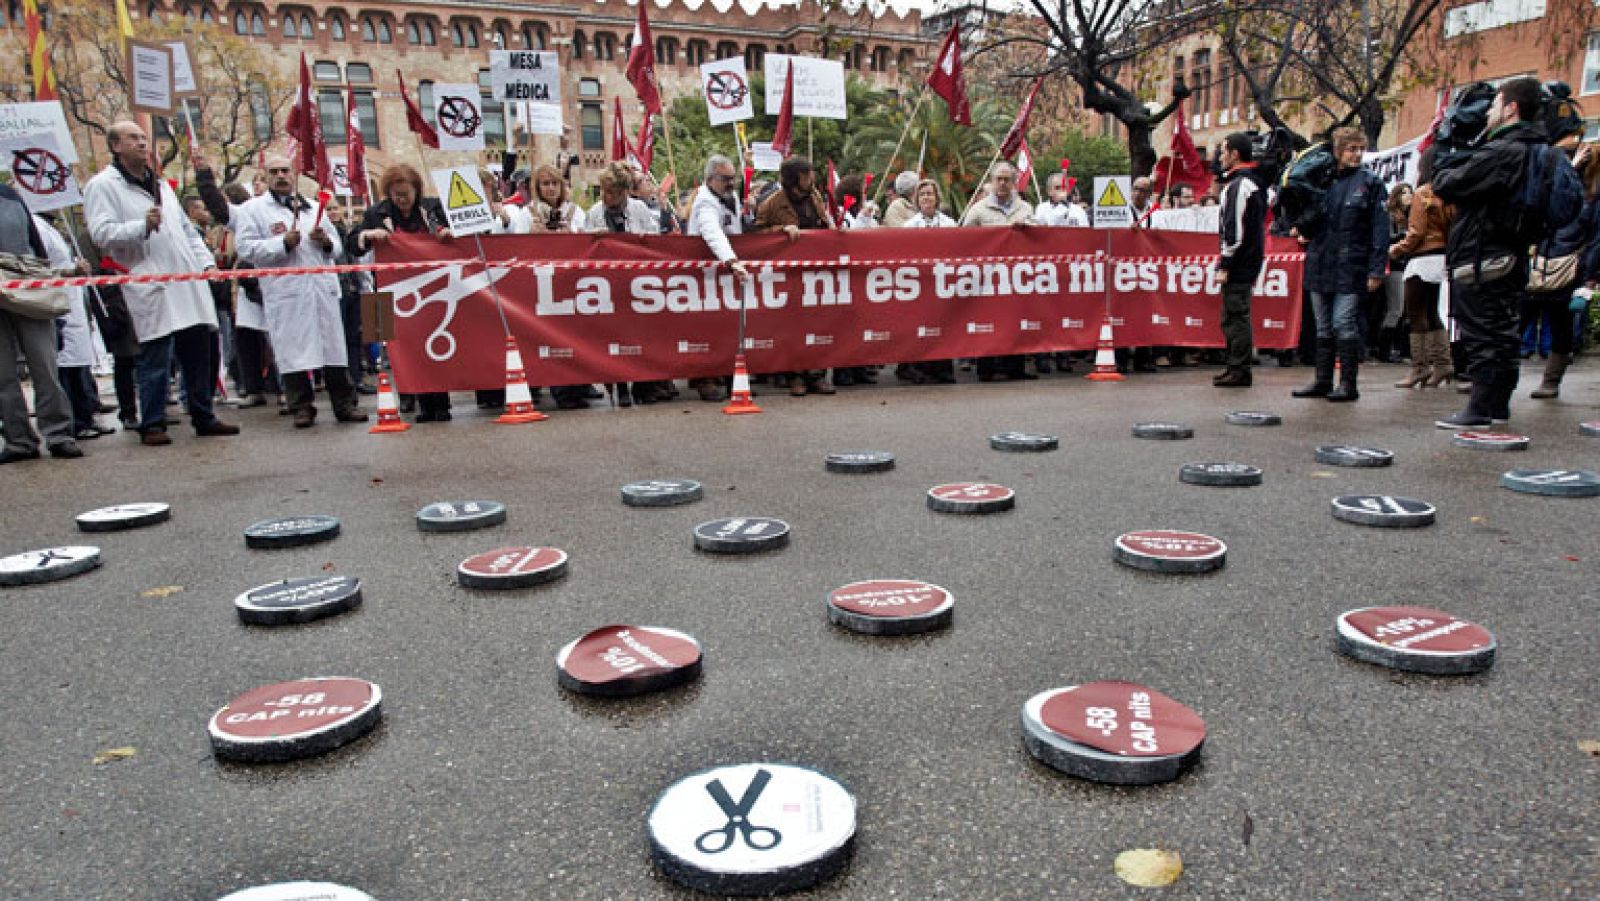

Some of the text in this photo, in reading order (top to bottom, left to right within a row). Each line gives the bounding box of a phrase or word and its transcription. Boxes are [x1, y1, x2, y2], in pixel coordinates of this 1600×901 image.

[509, 51, 542, 70] MESA
[450, 208, 489, 222] PERILL
[533, 262, 615, 315] La
[630, 262, 789, 315] salut
[801, 254, 853, 307] ni
[866, 266, 921, 303] es
[933, 261, 1060, 299] tanca
[1068, 249, 1105, 293] ni
[1114, 260, 1160, 292] es
[264, 692, 326, 707] -58
[225, 705, 353, 724] CAP nits
[1127, 691, 1158, 752] CAP nits
